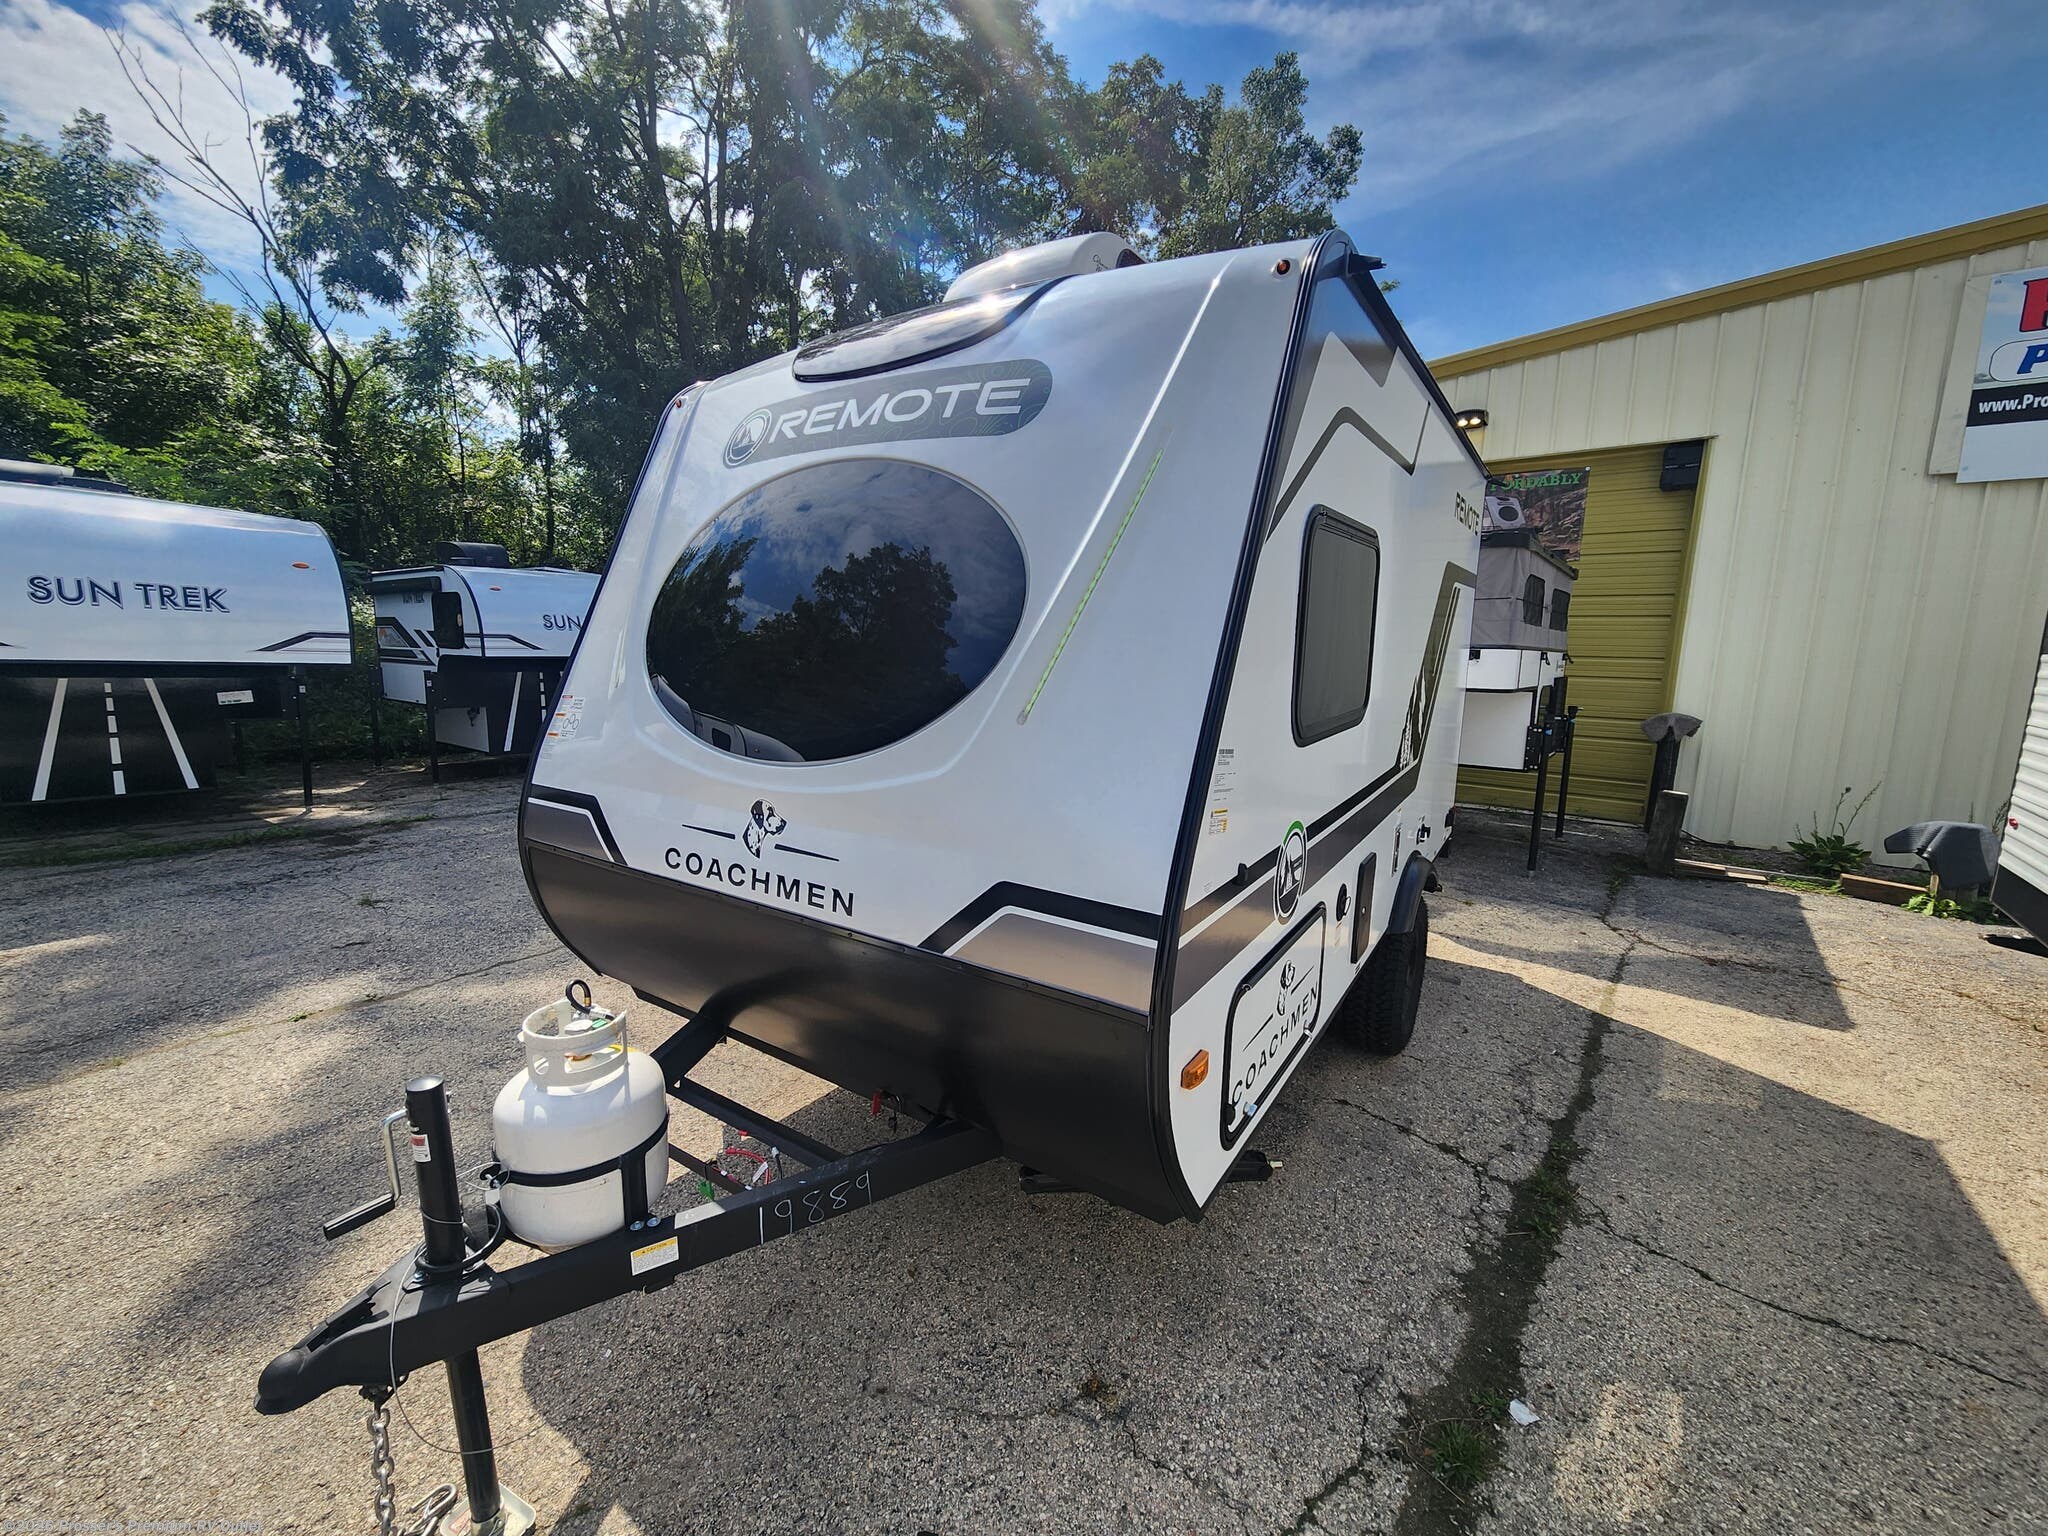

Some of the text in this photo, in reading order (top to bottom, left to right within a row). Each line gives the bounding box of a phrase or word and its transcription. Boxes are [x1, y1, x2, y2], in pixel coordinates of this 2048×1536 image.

[770, 378, 1031, 443] REMOTE
[1455, 491, 1480, 536] REMOTE
[27, 575, 230, 613] SUN TREK
[543, 614, 582, 631] SUN
[665, 847, 854, 917] COACHMEN
[1232, 981, 1318, 1107] COACHMEN
[759, 1170, 873, 1245] 19889
